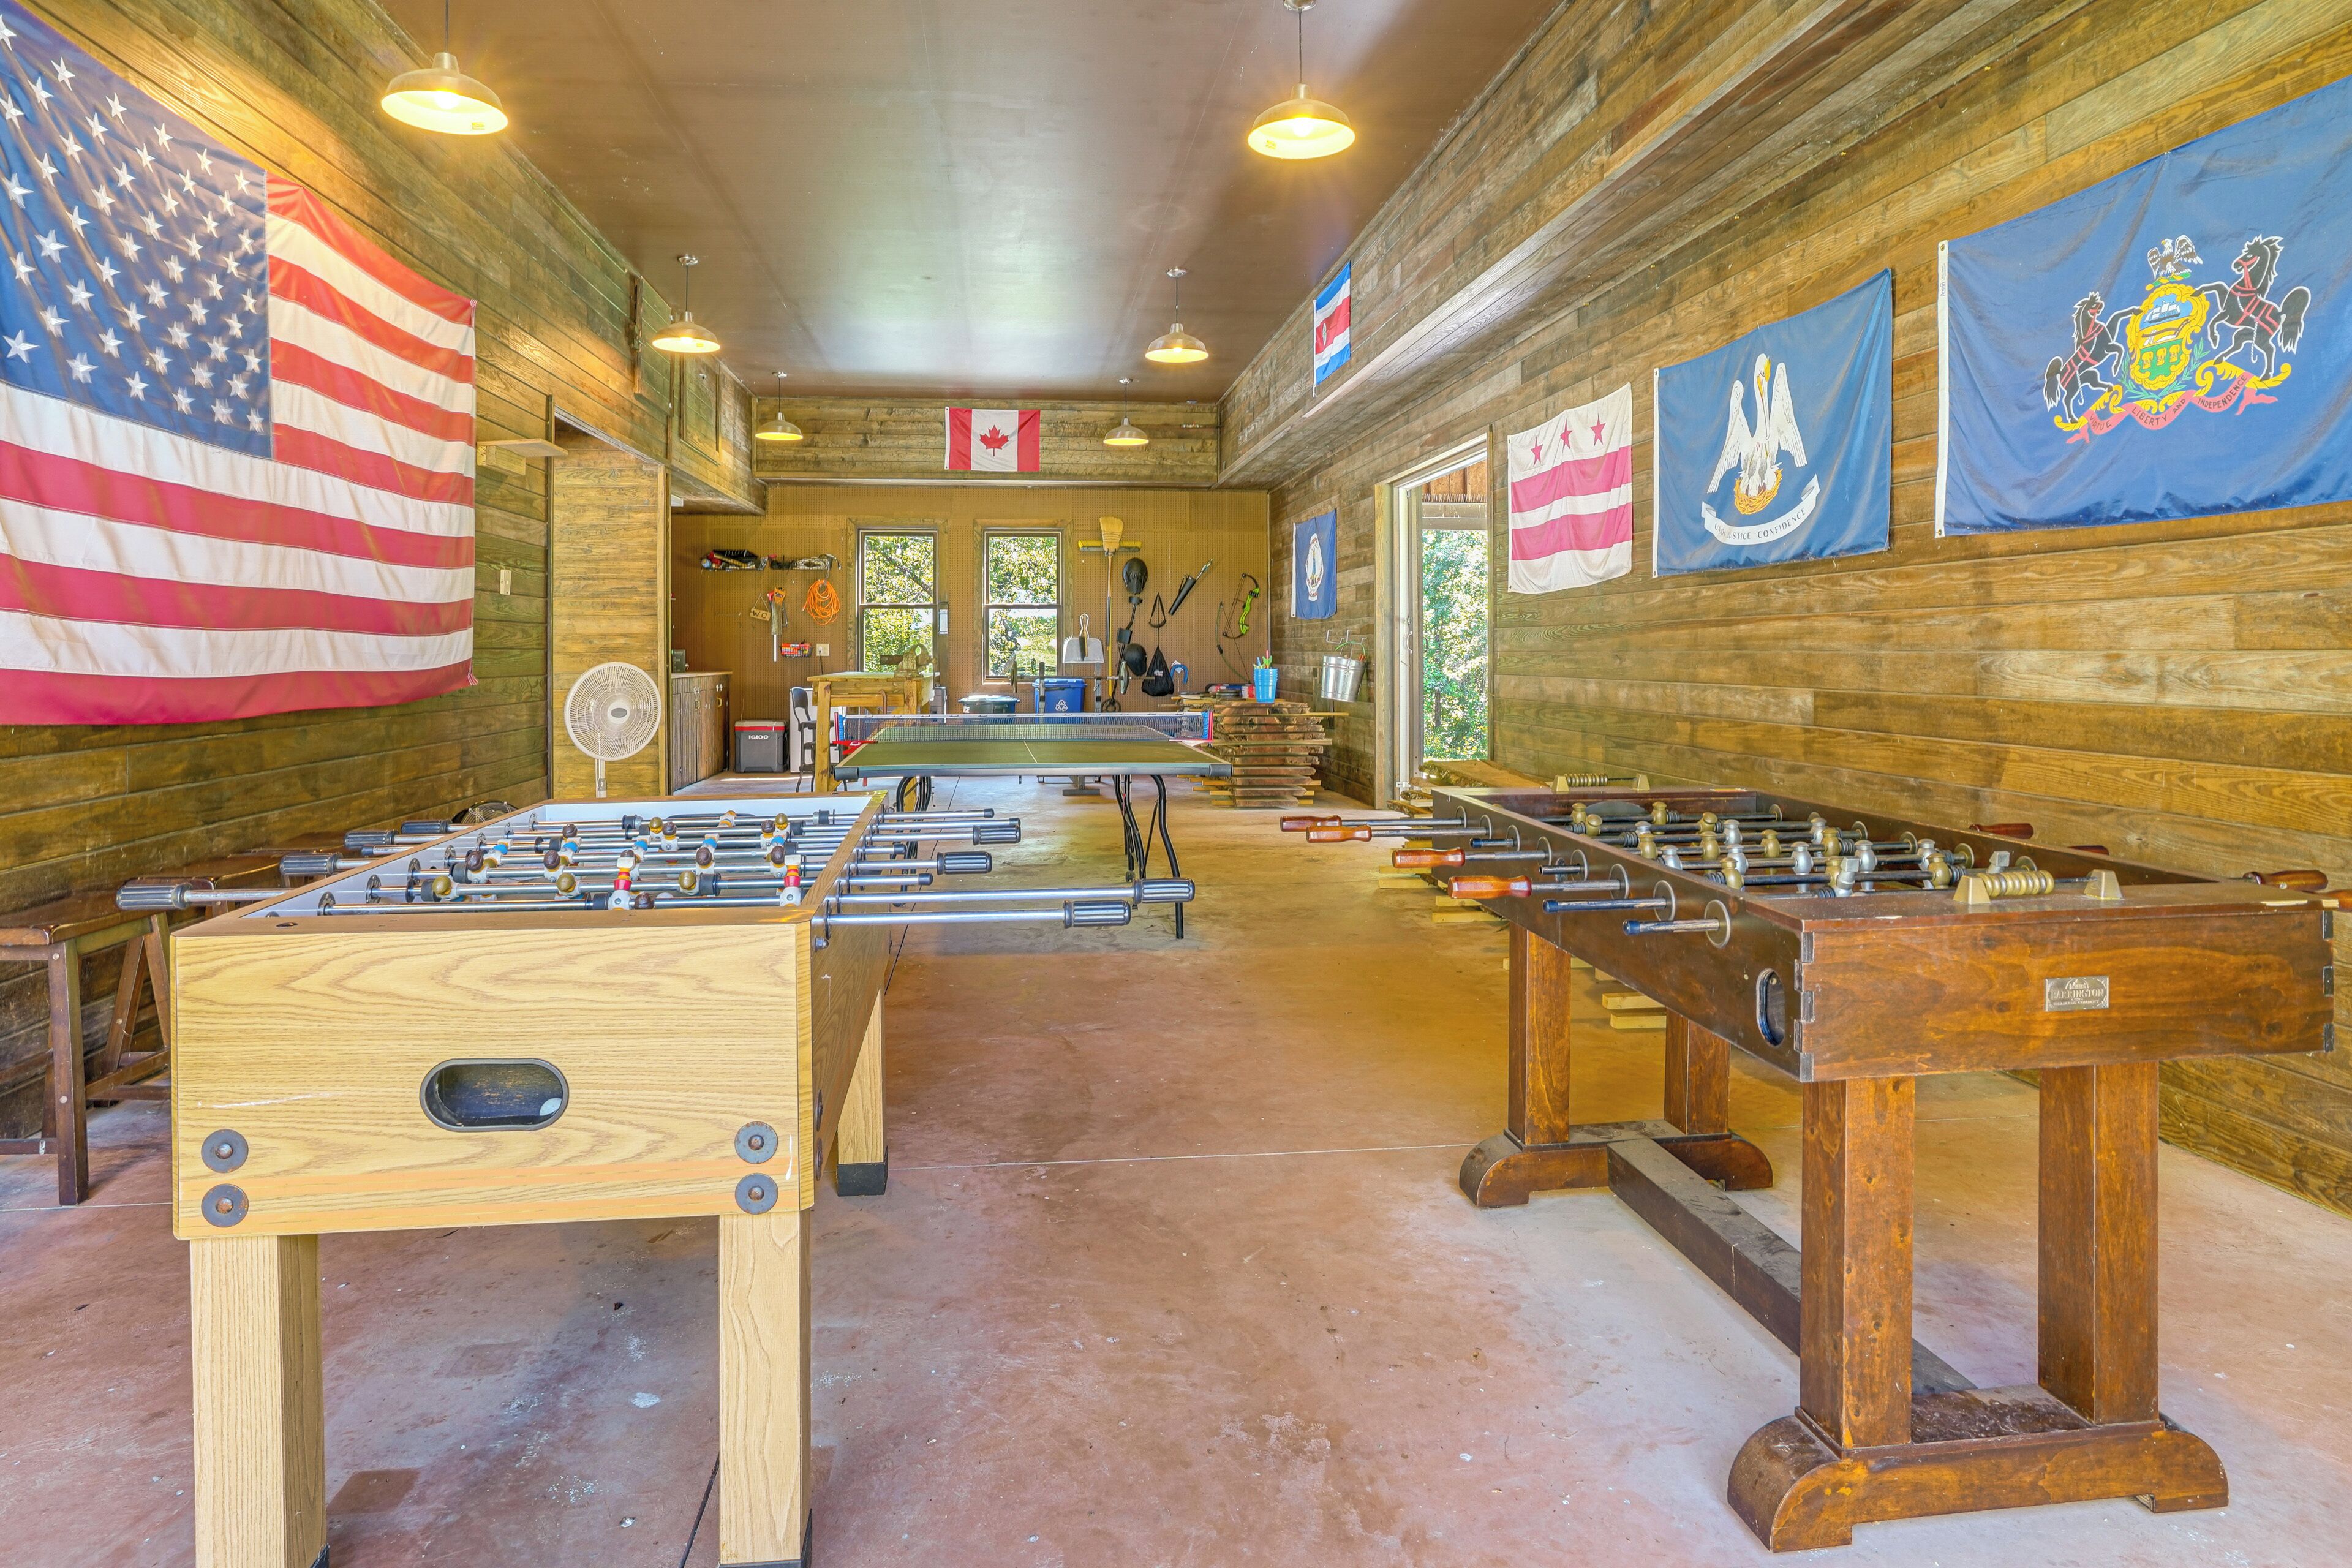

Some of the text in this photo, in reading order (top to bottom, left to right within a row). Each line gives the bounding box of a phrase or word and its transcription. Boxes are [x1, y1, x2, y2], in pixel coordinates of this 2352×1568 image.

[2089, 374, 2247, 431] VIRTUE LIBERTY AND INDEPENDENCE
[1757, 507, 1806, 538] CONFIDENCE
[2050, 988, 2104, 1000] BARRINGTON
